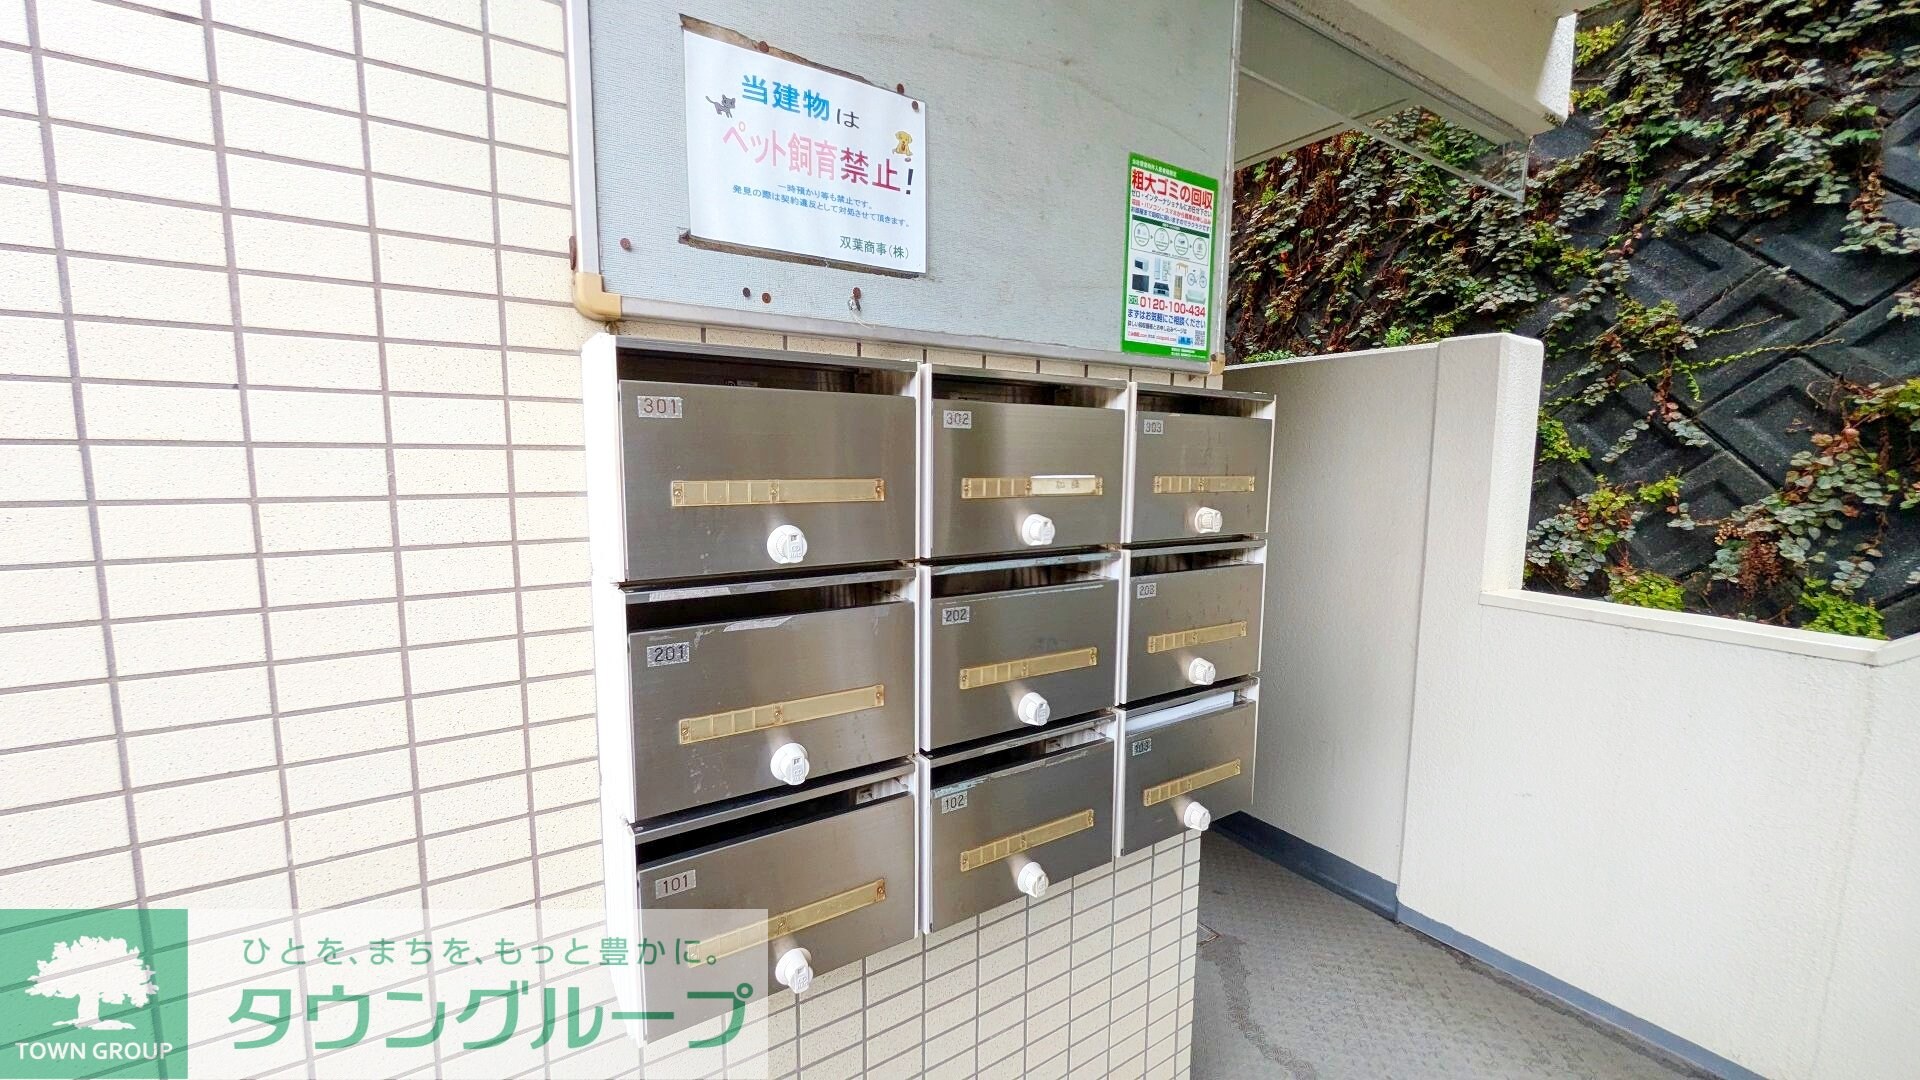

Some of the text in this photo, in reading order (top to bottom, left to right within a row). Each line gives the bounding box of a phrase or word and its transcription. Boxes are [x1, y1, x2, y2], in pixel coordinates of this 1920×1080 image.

[742, 74, 860, 129] 当建物は
[722, 121, 914, 195] ペット飼育禁止!
[777, 184, 873, 210] 一時預かり等も禁止です。
[1132, 168, 1213, 210] 粗大ゴミの回収
[839, 235, 910, 260] 双葉商事(株)
[1139, 296, 1206, 318] 0120-100-434
[642, 397, 679, 415] 301
[945, 411, 970, 426] 302
[944, 608, 968, 622] 202
[653, 645, 686, 663] 201
[945, 794, 964, 809] 102
[662, 873, 690, 894] 101
